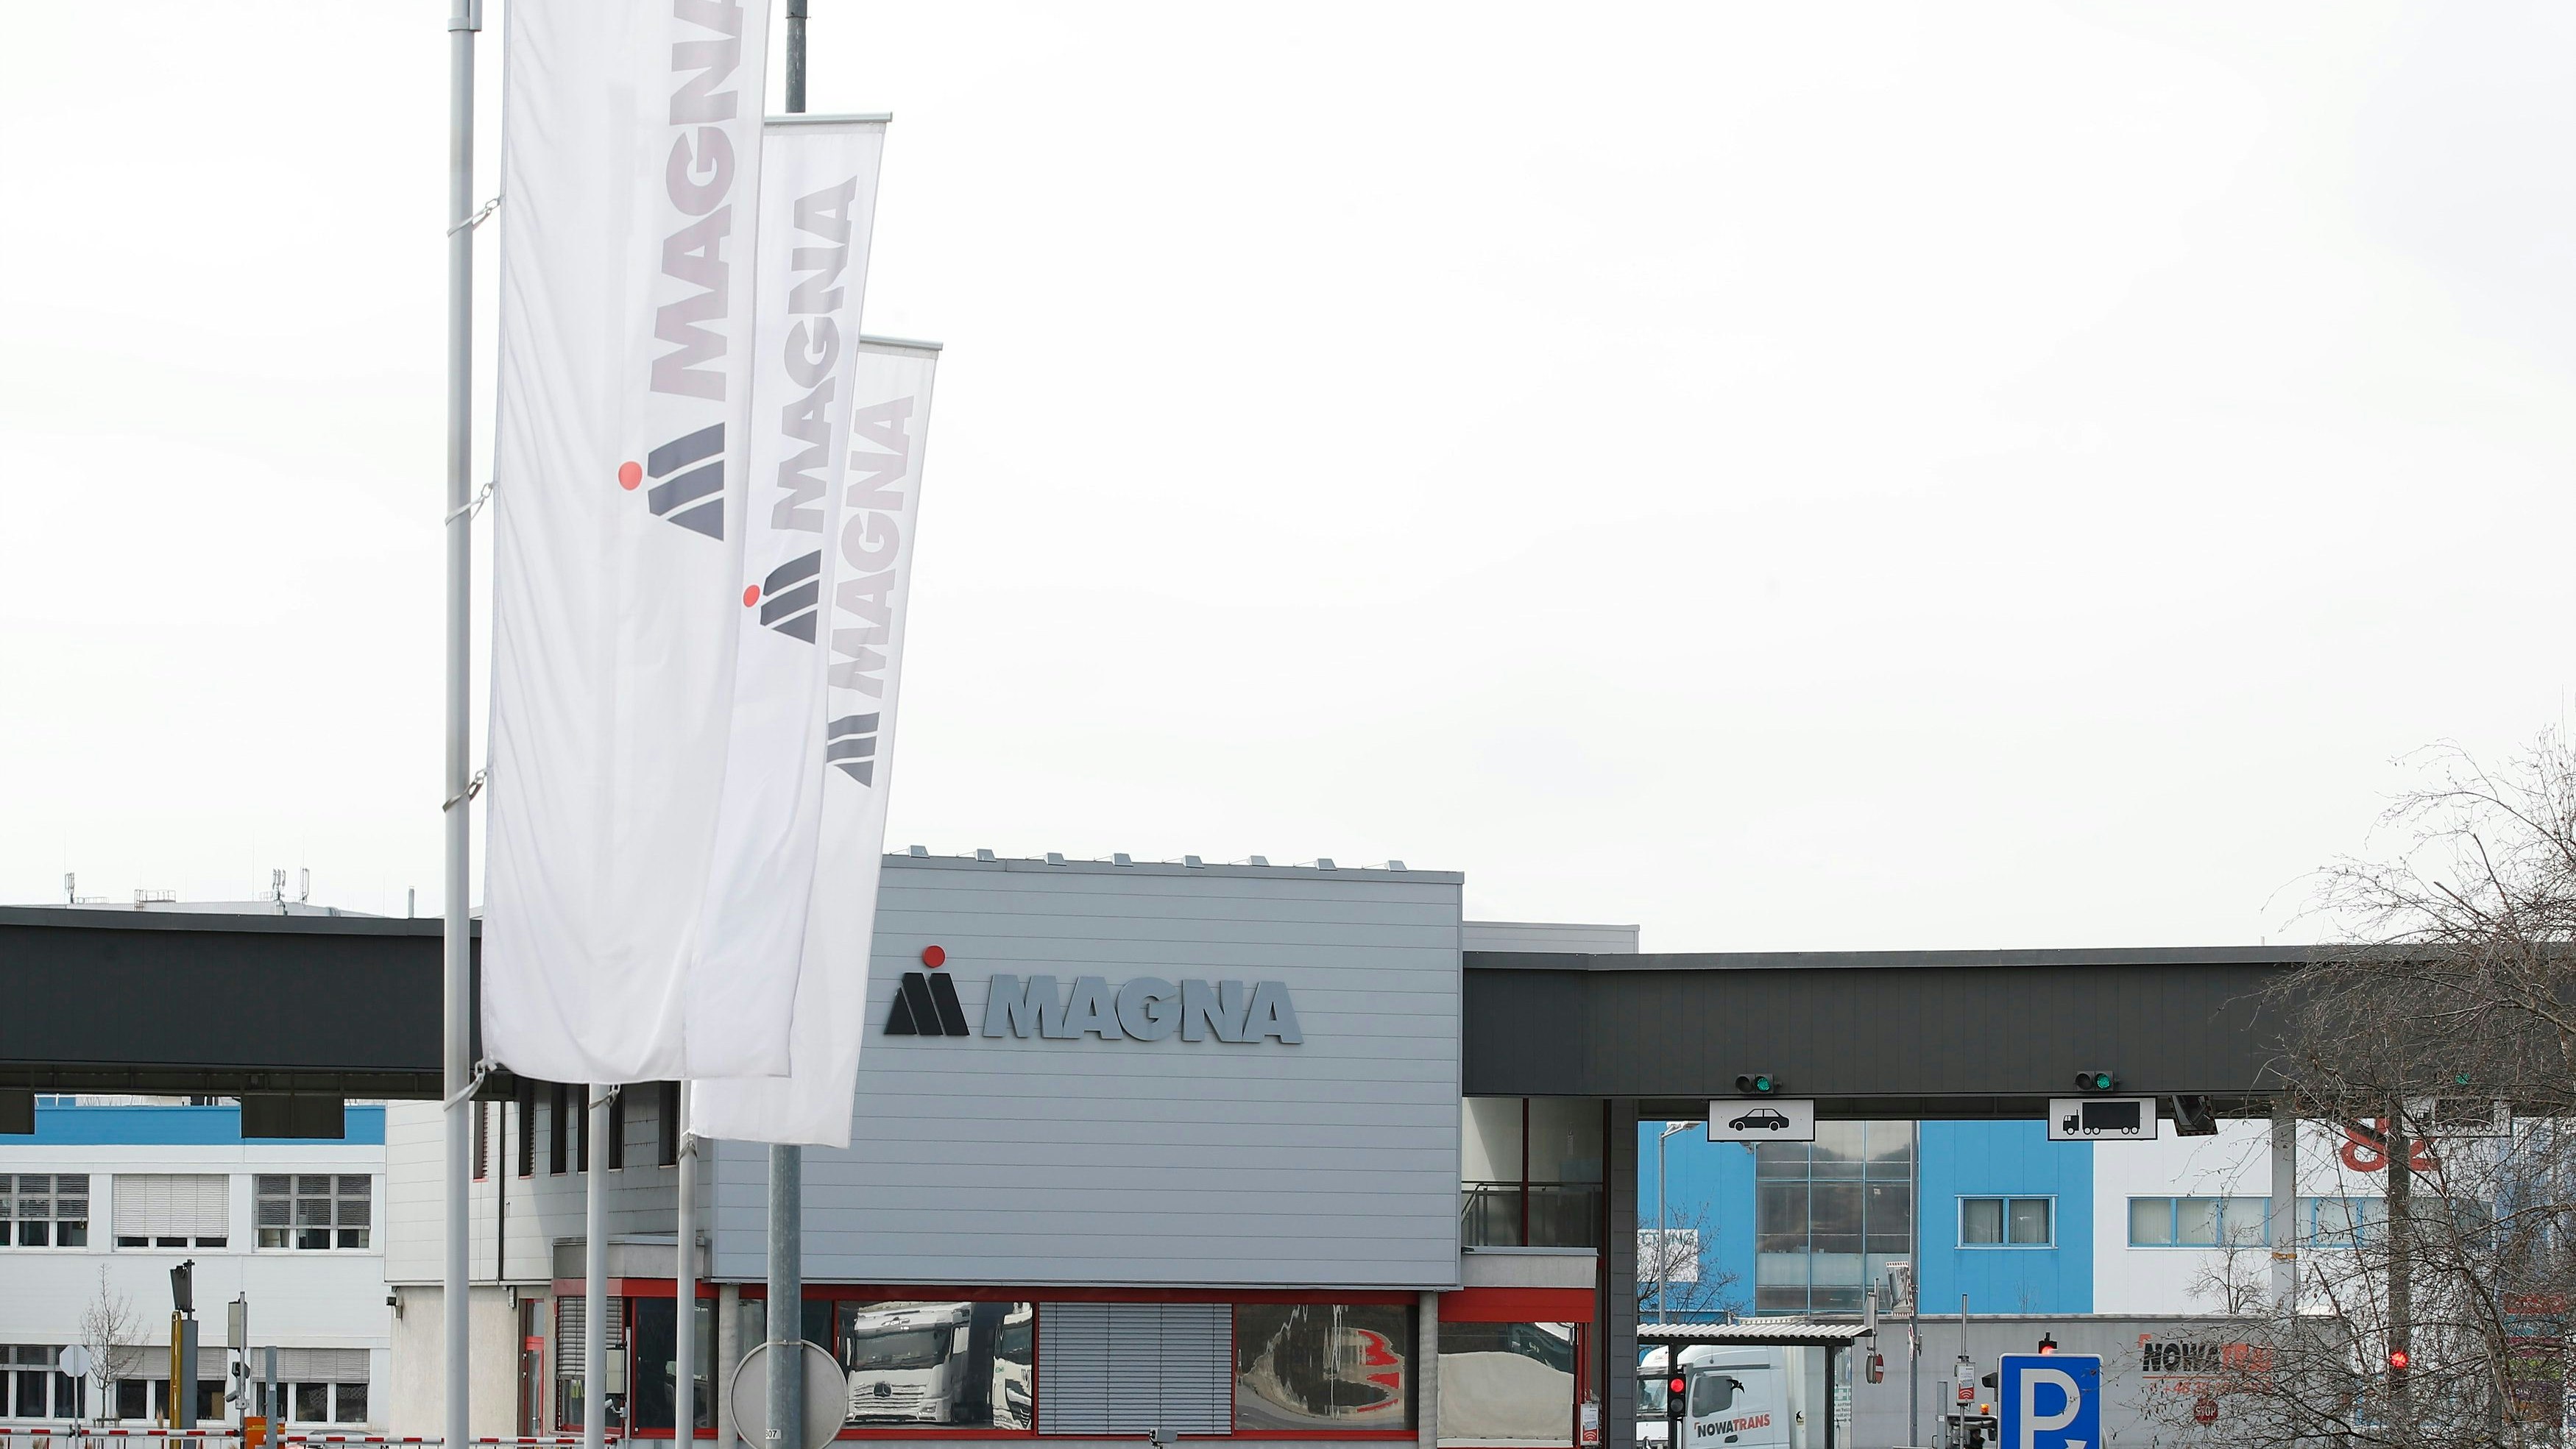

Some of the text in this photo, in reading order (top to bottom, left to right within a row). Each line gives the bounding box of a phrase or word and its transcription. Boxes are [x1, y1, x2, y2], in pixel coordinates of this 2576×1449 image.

[771, 175, 857, 534] MAGNA
[828, 396, 914, 698] MAGNA
[983, 974, 1304, 1044] MAGNA
[1697, 1414, 1771, 1438] NOWATRANS
[2020, 1368, 2081, 1449] P
[2195, 1406, 2216, 1417] STOP
